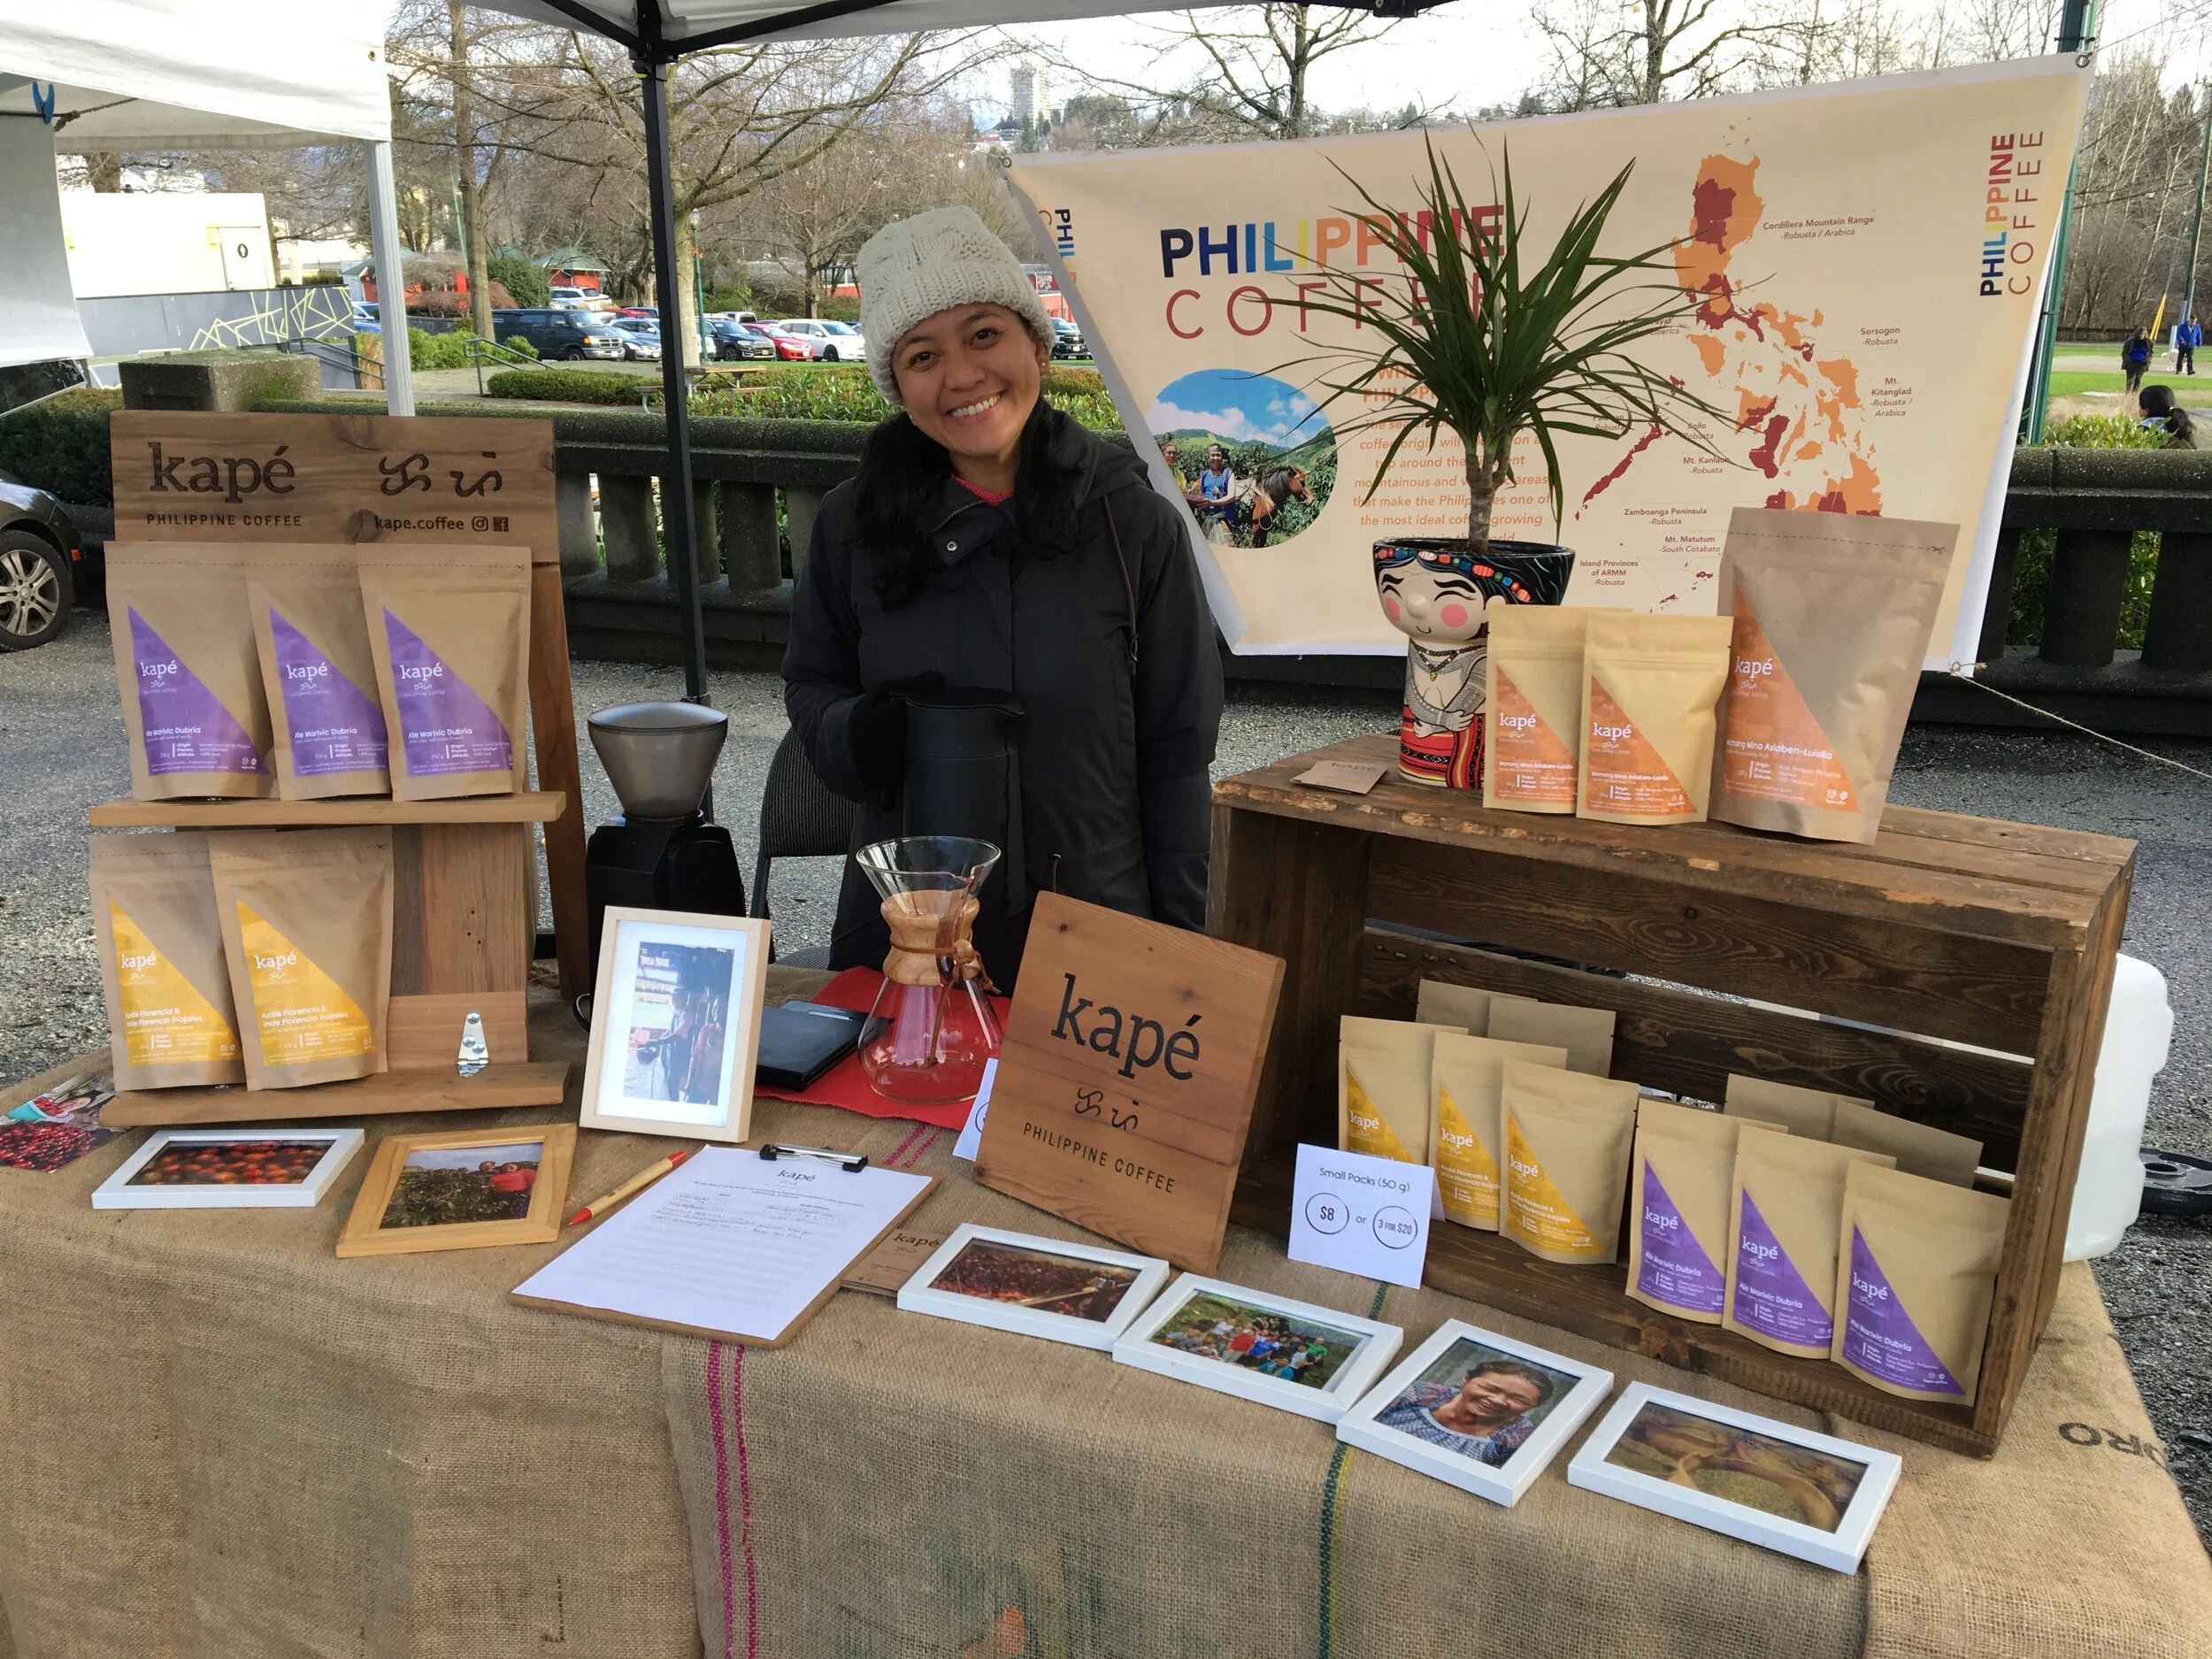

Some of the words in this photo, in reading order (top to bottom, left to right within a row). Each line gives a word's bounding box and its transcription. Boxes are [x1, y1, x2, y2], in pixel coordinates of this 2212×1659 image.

[1980, 134, 2015, 296] PHILIPPINE
[2008, 131, 2044, 295] COFFEE
[1763, 221, 1803, 230] Cordillera
[1806, 219, 1845, 227] Mountain
[1847, 216, 1874, 225] Range
[1781, 231, 1816, 240] -Robusta
[1824, 228, 1855, 237] Arabica
[1871, 387, 1912, 396] Kitanglad
[1514, 435, 1532, 445] on
[1400, 456, 1442, 468] around
[148, 442, 296, 503] kapé
[1434, 474, 1457, 487] and
[1516, 475, 1548, 484] areas
[1379, 495, 1411, 507] make
[1415, 494, 1435, 506] the
[1509, 495, 1533, 504] one
[1538, 494, 1551, 505] of
[147, 514, 236, 526] PHILIPPINE
[242, 515, 302, 527] COFFEE
[375, 515, 465, 533] kape.coffee
[1360, 515, 1379, 526] the
[1383, 515, 1412, 526] most
[1416, 513, 1446, 525] ideal
[1491, 514, 1543, 526] growing
[140, 660, 177, 678] kapé
[286, 662, 328, 680] kapé
[400, 663, 442, 681] kapé
[1734, 656, 1772, 679] kapé
[1500, 712, 1536, 730] kapé
[305, 729, 329, 738] Marivic
[1593, 722, 1632, 741] kapé
[121, 951, 157, 971] kapé
[254, 950, 297, 970] kapé
[1050, 972, 1202, 1080] kapé
[1350, 1111, 1379, 1130] kapé
[1441, 1128, 1473, 1148] kapé
[1022, 1122, 1108, 1166] PHILIPPINE
[1114, 1157, 1176, 1194] COFFEE
[1510, 1155, 1539, 1177] kapé
[777, 1169, 817, 1182] kapé
[1319, 1167, 1347, 1180] Small
[1348, 1172, 1375, 1187] Packs
[1378, 1178, 1396, 1189] (50
[1399, 1182, 1410, 1194] g)
[1320, 1205, 1334, 1221] $8
[1356, 1215, 1367, 1225] or
[1378, 1218, 1384, 1229] 3
[1385, 1221, 1396, 1232] FOR
[1397, 1225, 1412, 1235] $20
[1645, 1206, 1678, 1229] kapé
[1741, 1235, 1778, 1259] kapé
[1853, 1271, 1888, 1300] kapé
